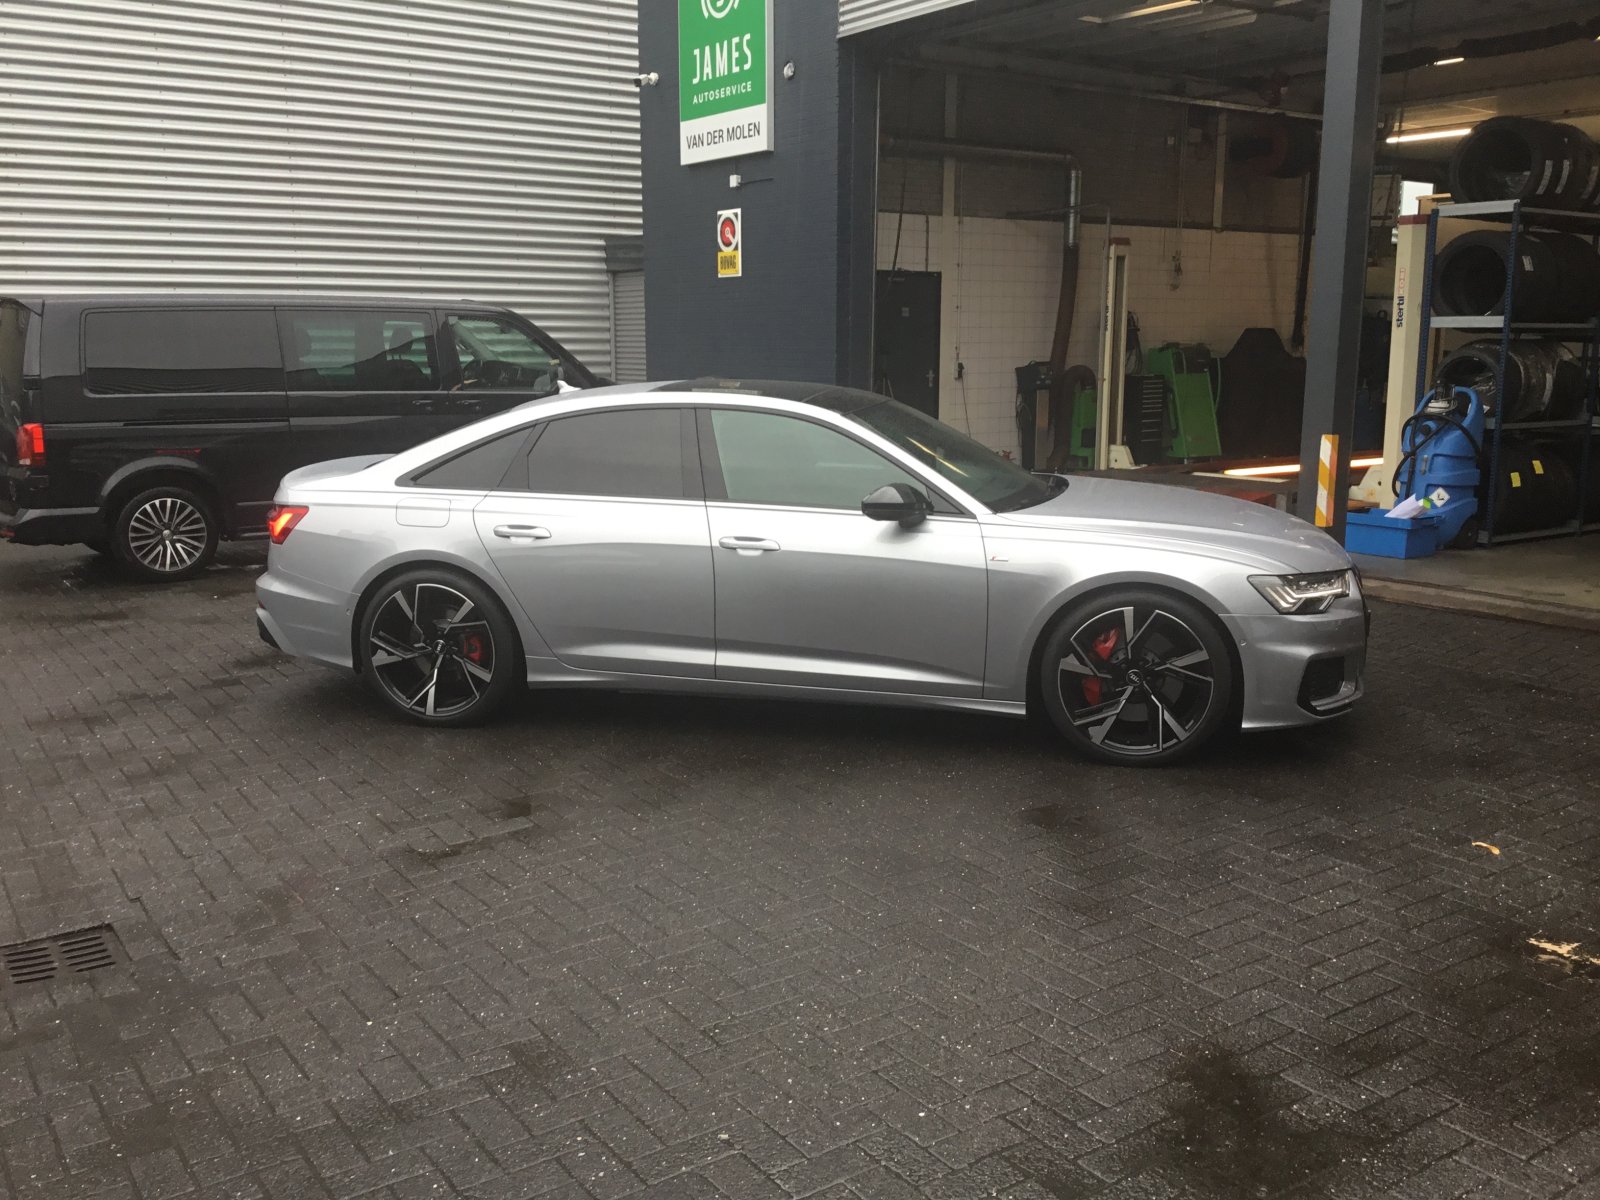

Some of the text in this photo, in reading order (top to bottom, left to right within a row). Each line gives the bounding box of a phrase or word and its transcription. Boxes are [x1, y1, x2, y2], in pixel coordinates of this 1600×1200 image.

[692, 33, 752, 84] JAMES
[692, 81, 752, 104] AUTOSERVICE
[686, 121, 761, 150] VAN DER MOLEN
[1396, 296, 1404, 328] stertil
